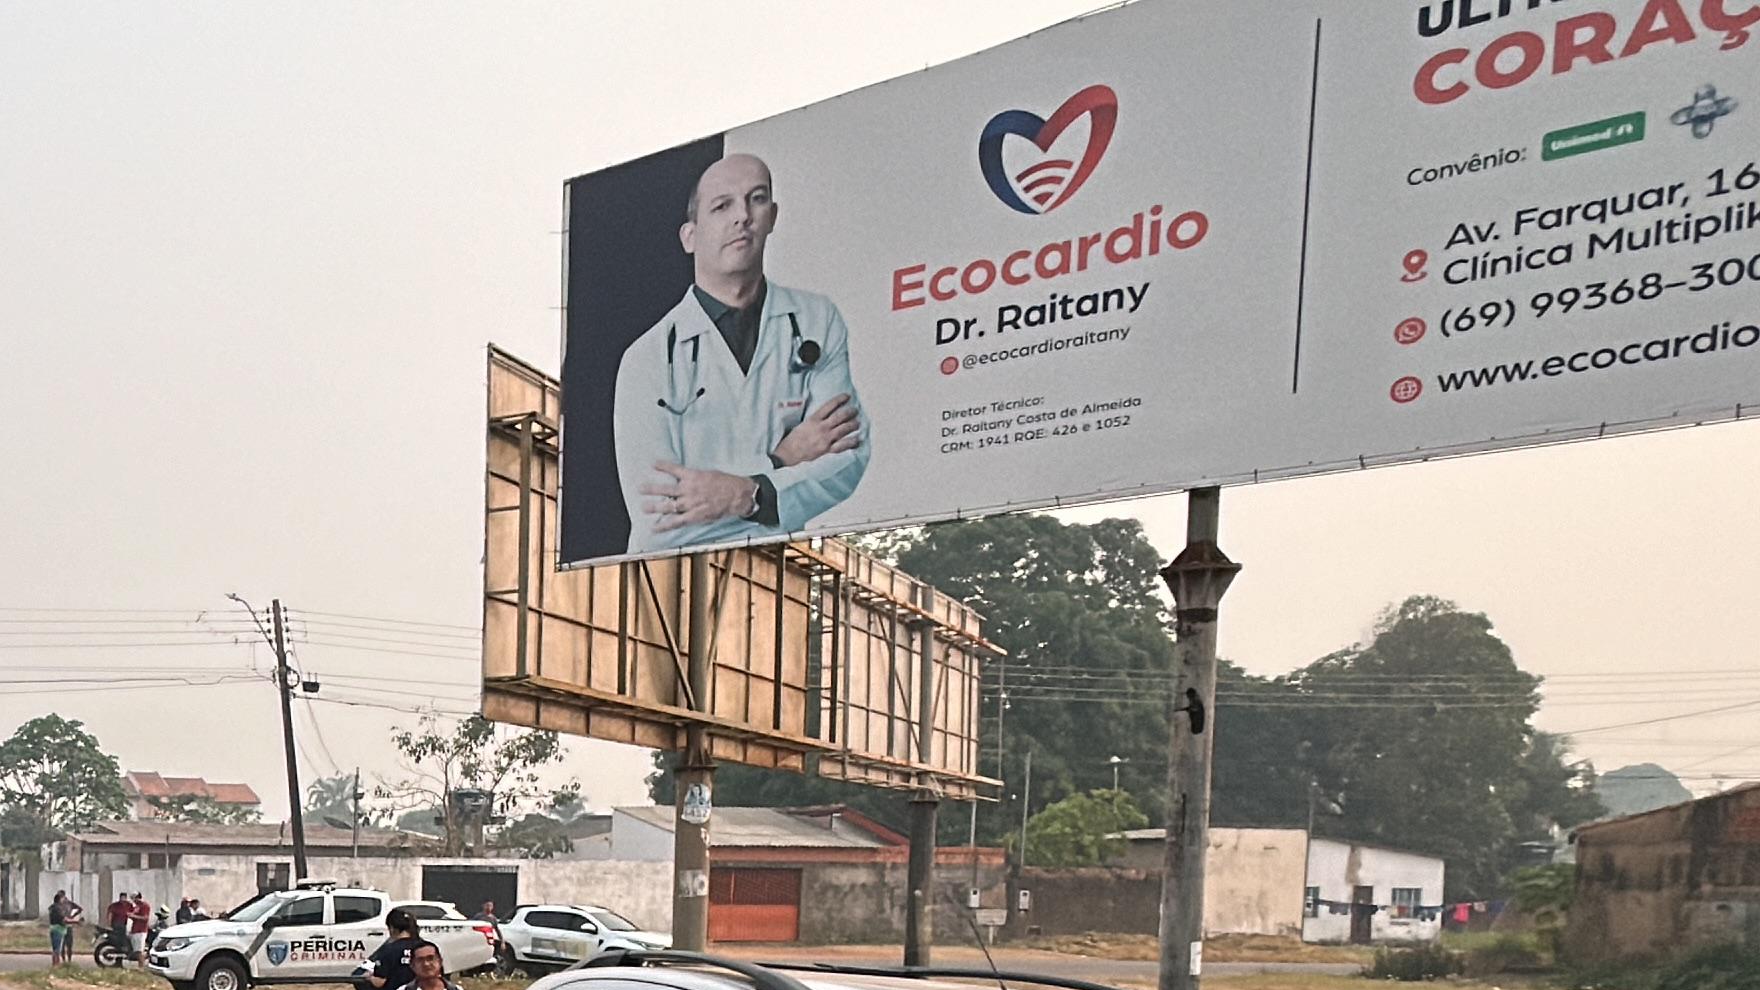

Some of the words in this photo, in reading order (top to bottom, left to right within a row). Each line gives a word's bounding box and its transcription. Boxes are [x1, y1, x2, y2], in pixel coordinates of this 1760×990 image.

[1407, 148, 1527, 185] Convênio:
[1444, 221, 1500, 250] Av.
[1514, 182, 1689, 236] Farquar,
[892, 204, 1209, 311] Ecocardio
[1443, 243, 1573, 285] Clínica
[935, 317, 985, 345] Dr.
[997, 282, 1150, 334] Raitany
[1440, 299, 1516, 337] (69)
[962, 326, 1131, 369] @ecocardioraitany
[1437, 321, 1760, 393] www.ecocardio
[941, 426, 958, 438] Dr.
[963, 418, 1013, 434] Raitany
[1016, 411, 1056, 425] Costa
[1060, 406, 1078, 418] de
[1082, 396, 1142, 415] Almeida
[942, 406, 987, 421] Diretor
[991, 396, 1044, 413] Técnico:
[940, 441, 974, 454] CRM:
[978, 434, 1009, 448] 1941
[1052, 424, 1078, 436] 426
[1082, 422, 1091, 432] e
[1096, 415, 1131, 430] 1052
[290, 937, 366, 952] PERÍCIA
[290, 952, 365, 960] CRIMINAL
